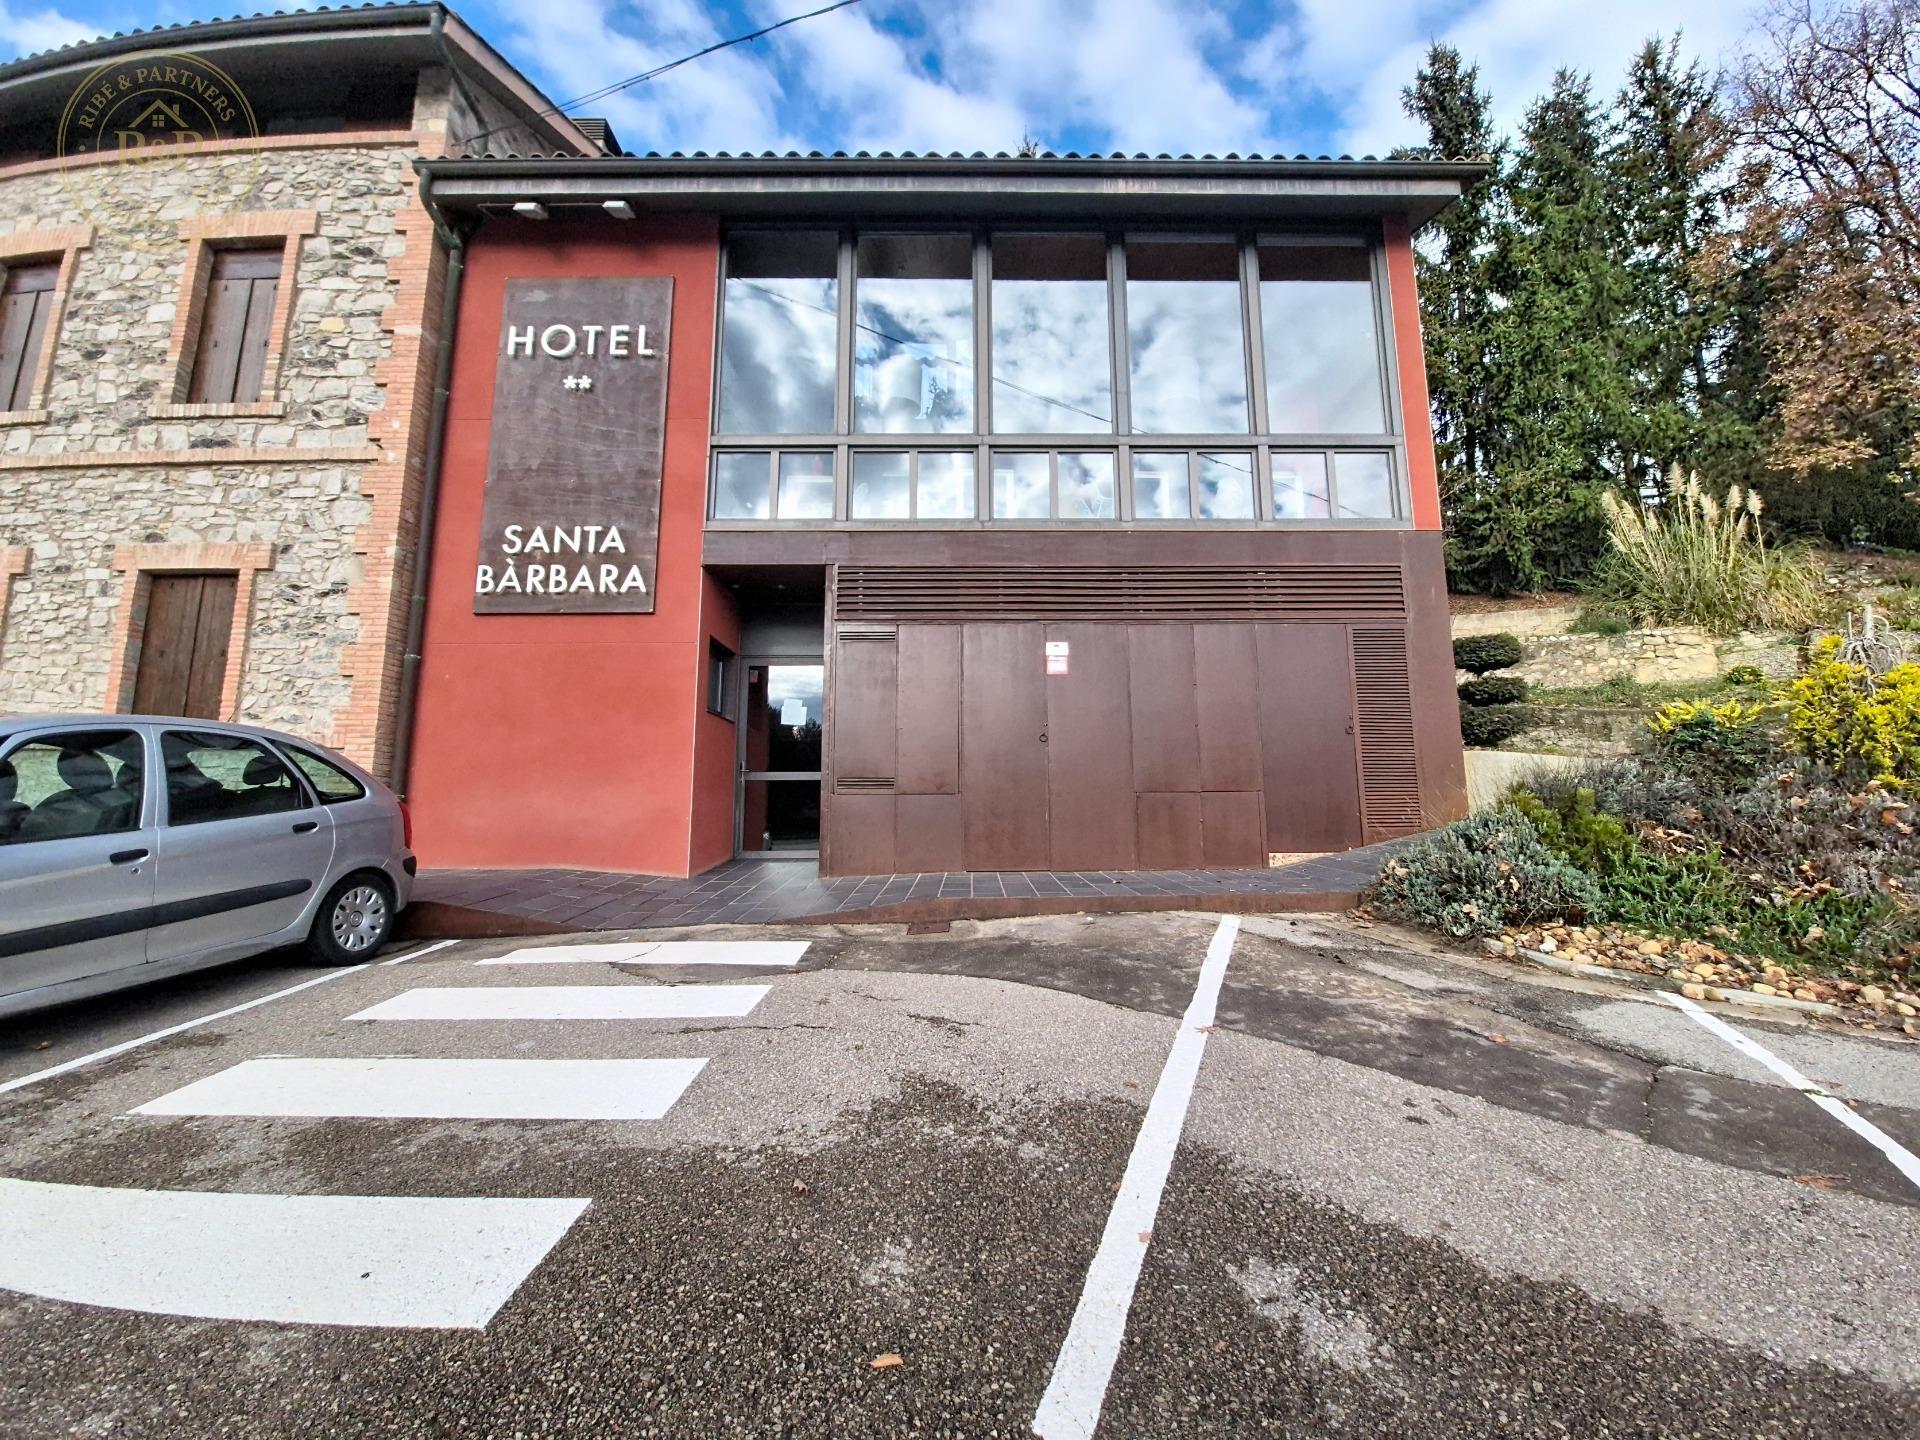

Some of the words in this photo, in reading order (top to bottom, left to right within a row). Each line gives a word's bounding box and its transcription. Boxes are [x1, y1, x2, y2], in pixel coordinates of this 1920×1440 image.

[507, 324, 656, 357] HOTEL
[502, 524, 626, 555] SANTA
[475, 558, 648, 594] BÀRBARA
